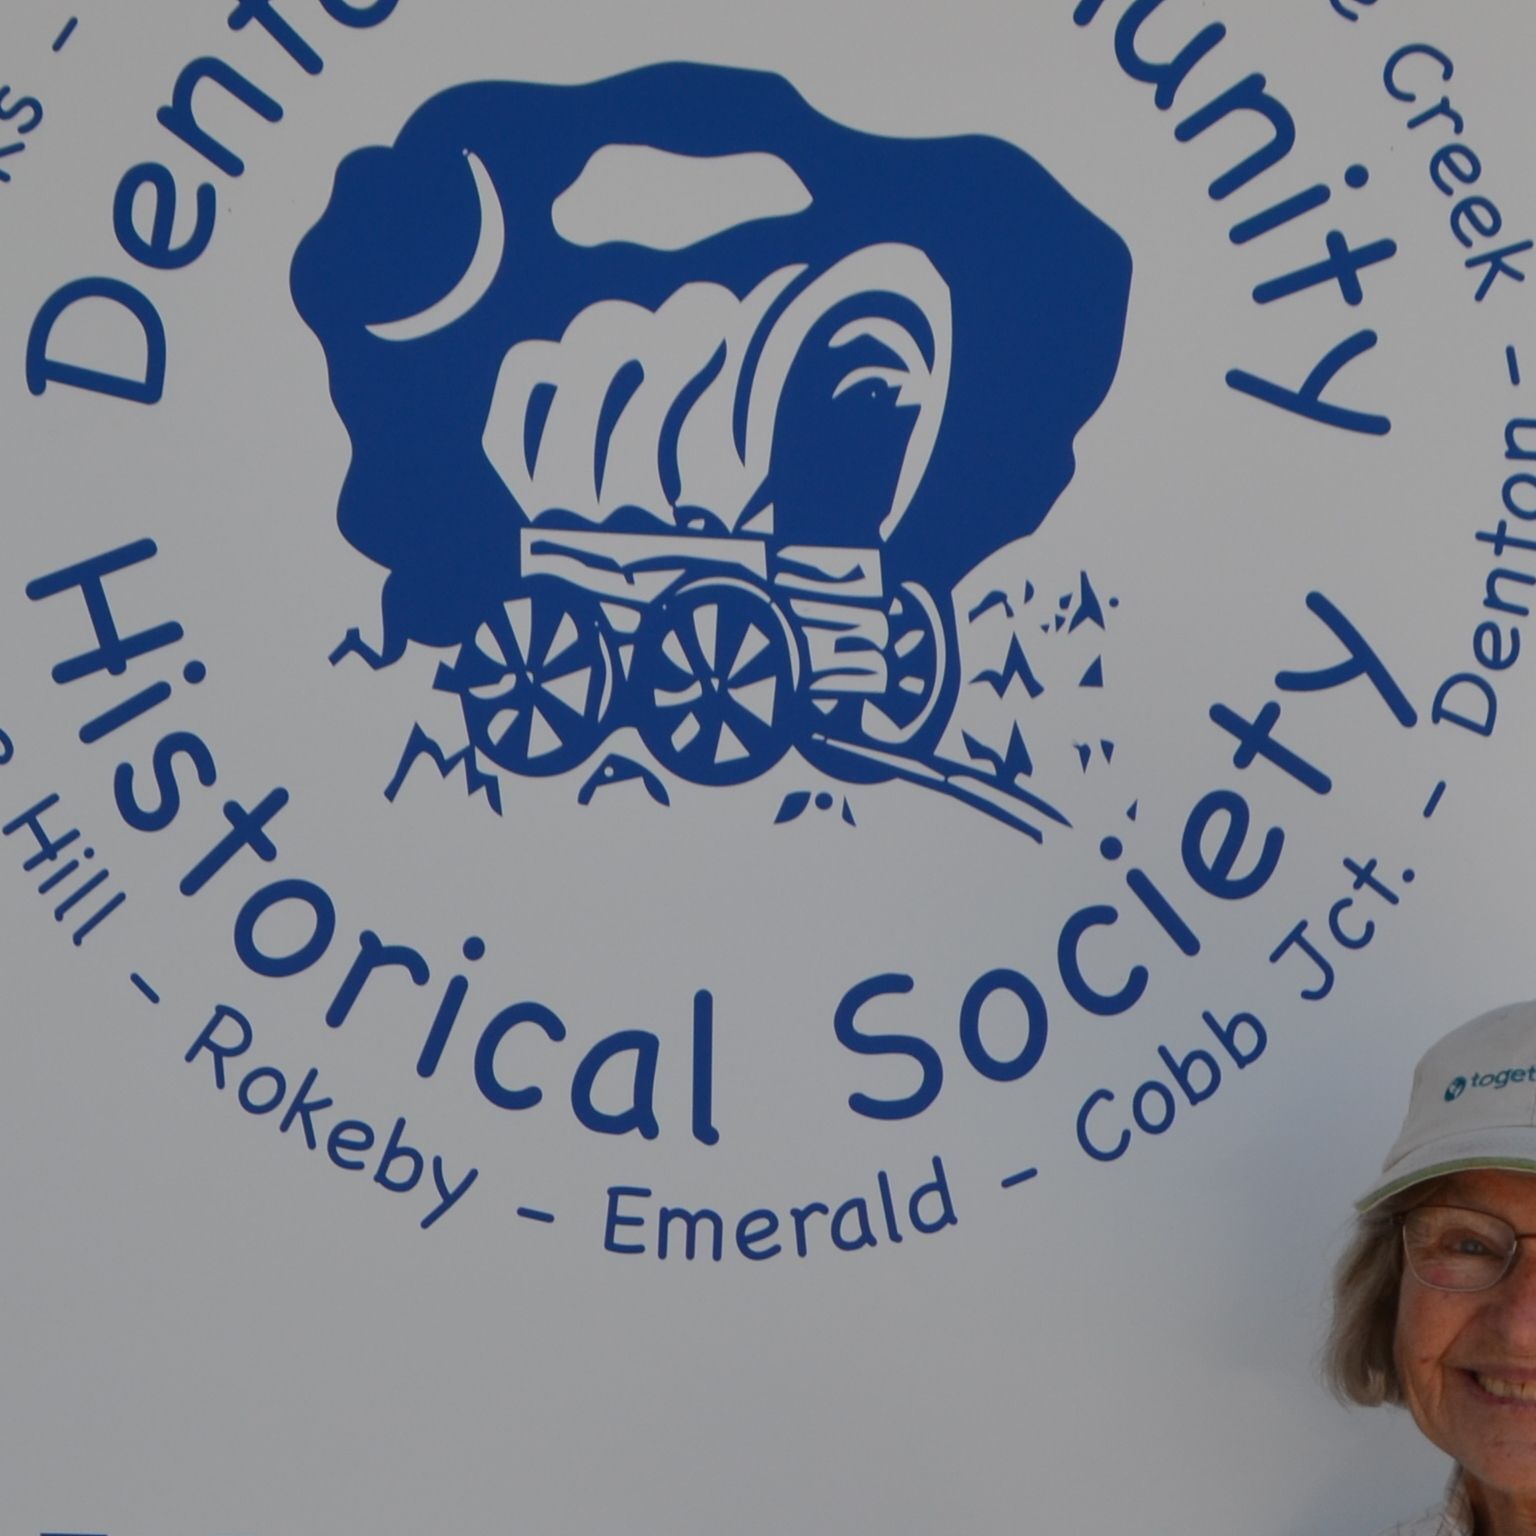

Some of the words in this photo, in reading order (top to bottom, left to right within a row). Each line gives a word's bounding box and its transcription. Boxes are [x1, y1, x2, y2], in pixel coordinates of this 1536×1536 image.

[24, 0, 401, 406] Dent
[1072, 0, 1398, 436] unity
[1381, 43, 1534, 302] Creek
[1, 793, 128, 947] Hill
[183, 1002, 480, 1229] Rokeby
[603, 1154, 959, 1261] Emerald
[1075, 1009, 1269, 1162] Cobb
[1267, 857, 1417, 1002] Jct.
[24, 535, 721, 1145] Historical
[833, 589, 1420, 1121] Society
